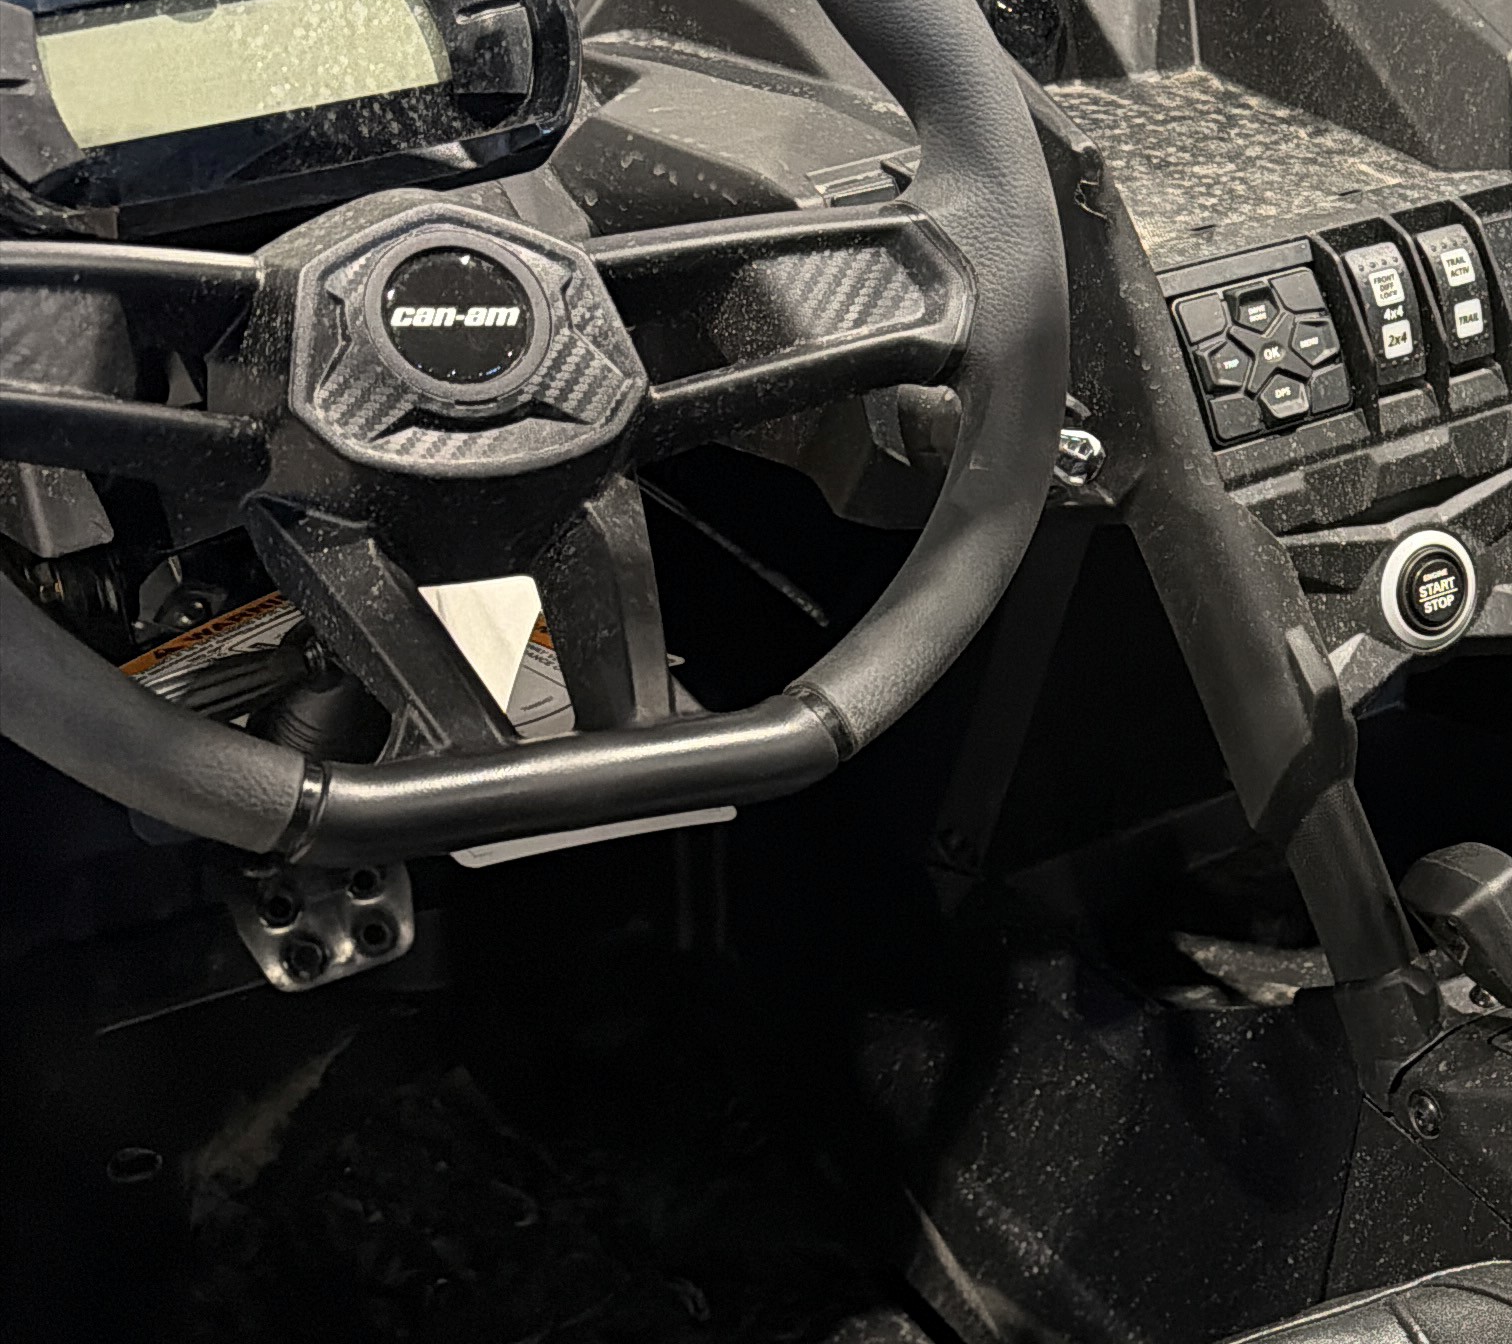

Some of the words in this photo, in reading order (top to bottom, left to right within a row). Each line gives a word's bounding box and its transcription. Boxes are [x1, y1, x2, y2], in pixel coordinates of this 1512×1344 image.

[1446, 257, 1467, 267] TRAIL
[1450, 266, 1470, 278] ACTIV
[1373, 274, 1395, 285] FRONT
[1379, 283, 1395, 292] DIFF
[390, 305, 521, 327] can-am
[1383, 306, 1404, 321] 4x4
[1459, 313, 1479, 325] TRAIL
[1387, 330, 1407, 346] 2x4
[1263, 347, 1281, 361] OK
[1275, 387, 1291, 398] DPS
[1419, 576, 1455, 598] START
[1424, 594, 1455, 614] STOP
